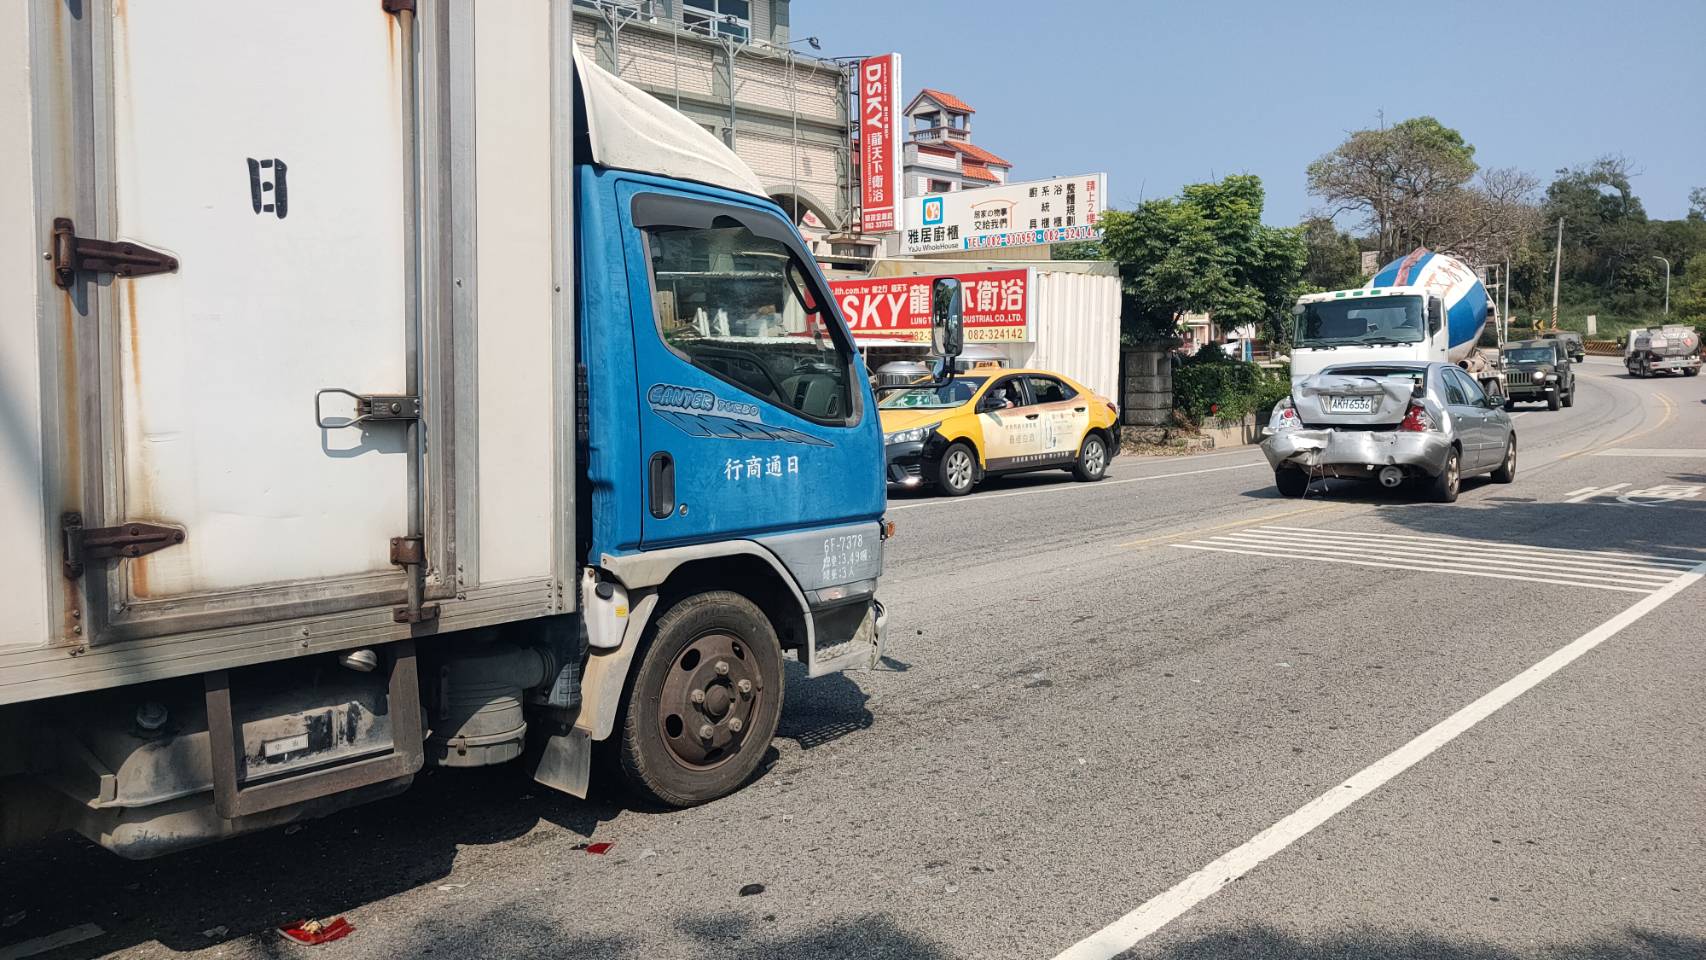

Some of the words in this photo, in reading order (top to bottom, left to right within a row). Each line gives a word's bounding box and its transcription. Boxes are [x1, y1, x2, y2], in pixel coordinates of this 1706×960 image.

[866, 63, 882, 129] DSKY
[871, 132, 884, 202] 龍天下衛浴
[907, 224, 960, 245] 雅居廚櫃
[842, 293, 908, 328] SKY
[967, 328, 1023, 340] 082-324142
[649, 384, 715, 411] CANTER
[717, 399, 760, 416] TURBO
